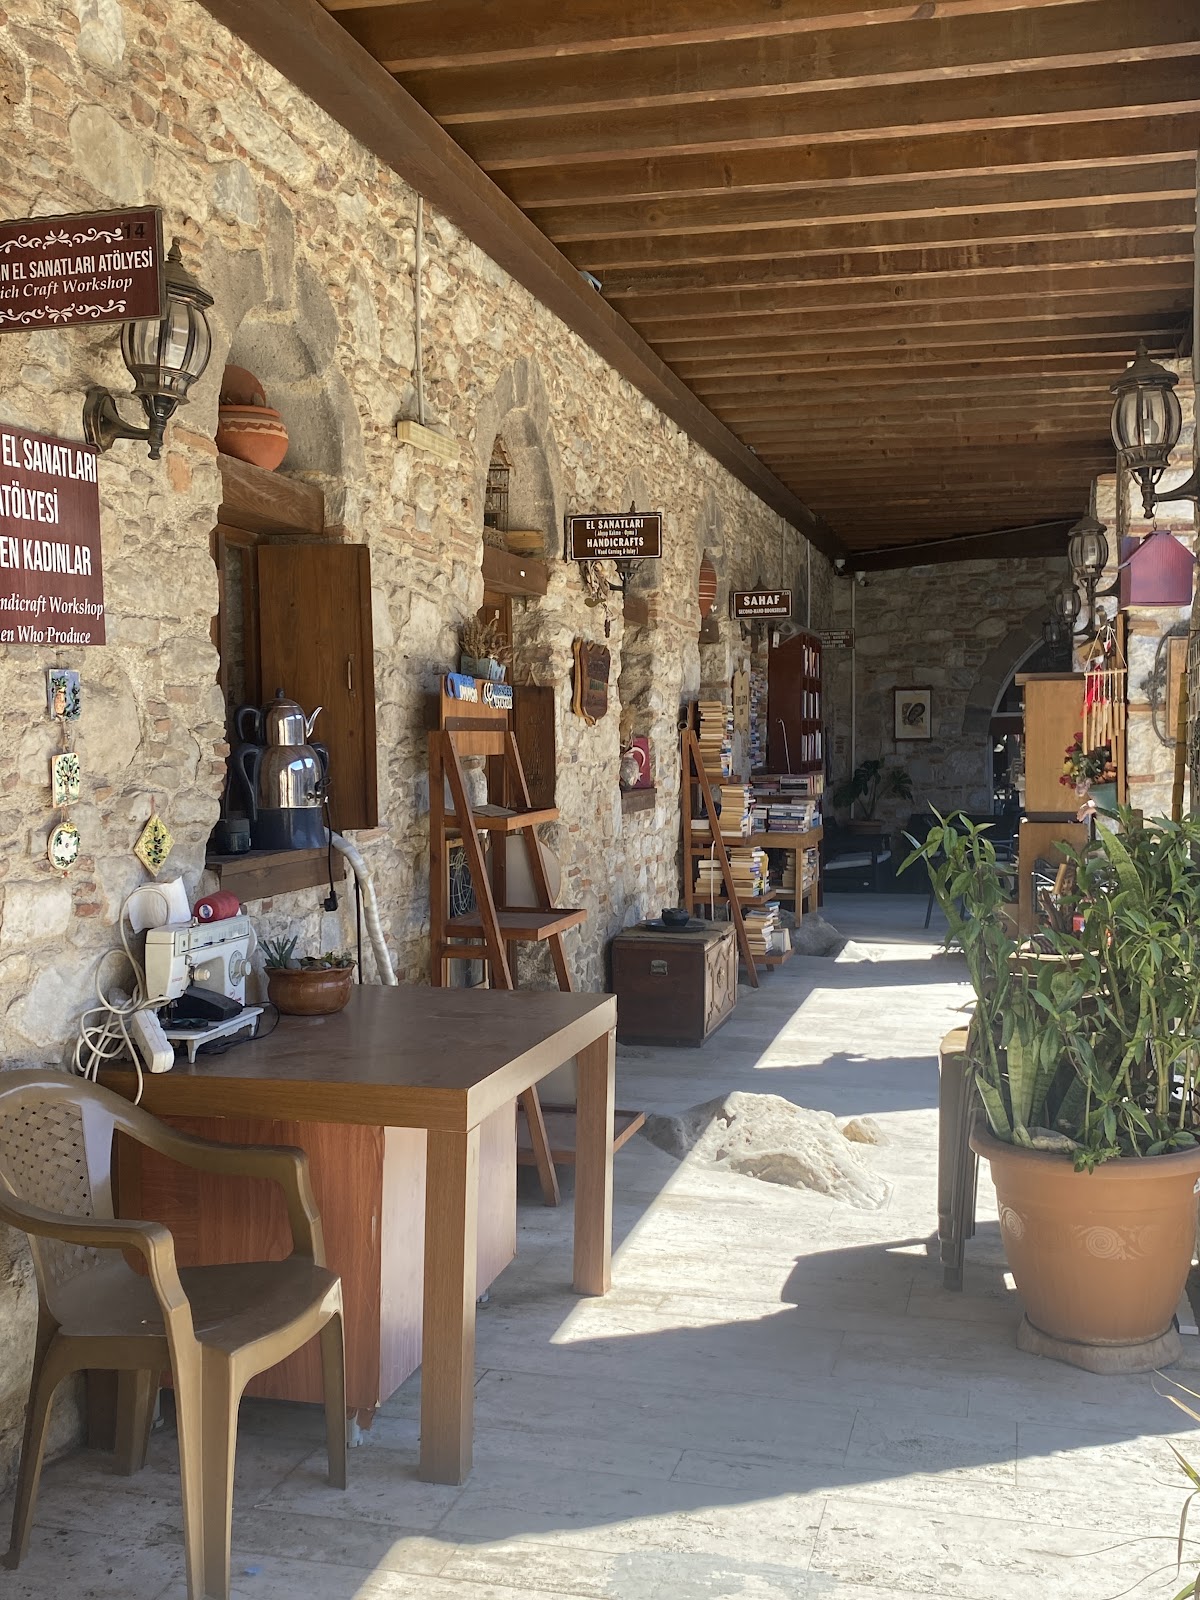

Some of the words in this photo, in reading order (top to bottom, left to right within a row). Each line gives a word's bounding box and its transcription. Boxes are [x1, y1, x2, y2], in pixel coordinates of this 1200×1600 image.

[124, 223, 145, 239] 14
[12, 262, 27, 280] EL
[29, 255, 95, 279] SANATLARI
[98, 246, 153, 272] ATÖLYESİ
[23, 280, 59, 300] Craft
[62, 275, 133, 293] Workshop
[2, 433, 21, 468] EL
[23, 437, 97, 484] SANATLARI
[586, 520, 595, 529] EL
[598, 519, 644, 529] SANATLARI
[587, 537, 644, 548] HANDICRAFTS
[23, 538, 92, 576] KADINLAR
[49, 596, 103, 620] Workshop
[743, 595, 780, 606] SAHAF
[17, 625, 44, 643] Who
[47, 626, 91, 644] Produce
